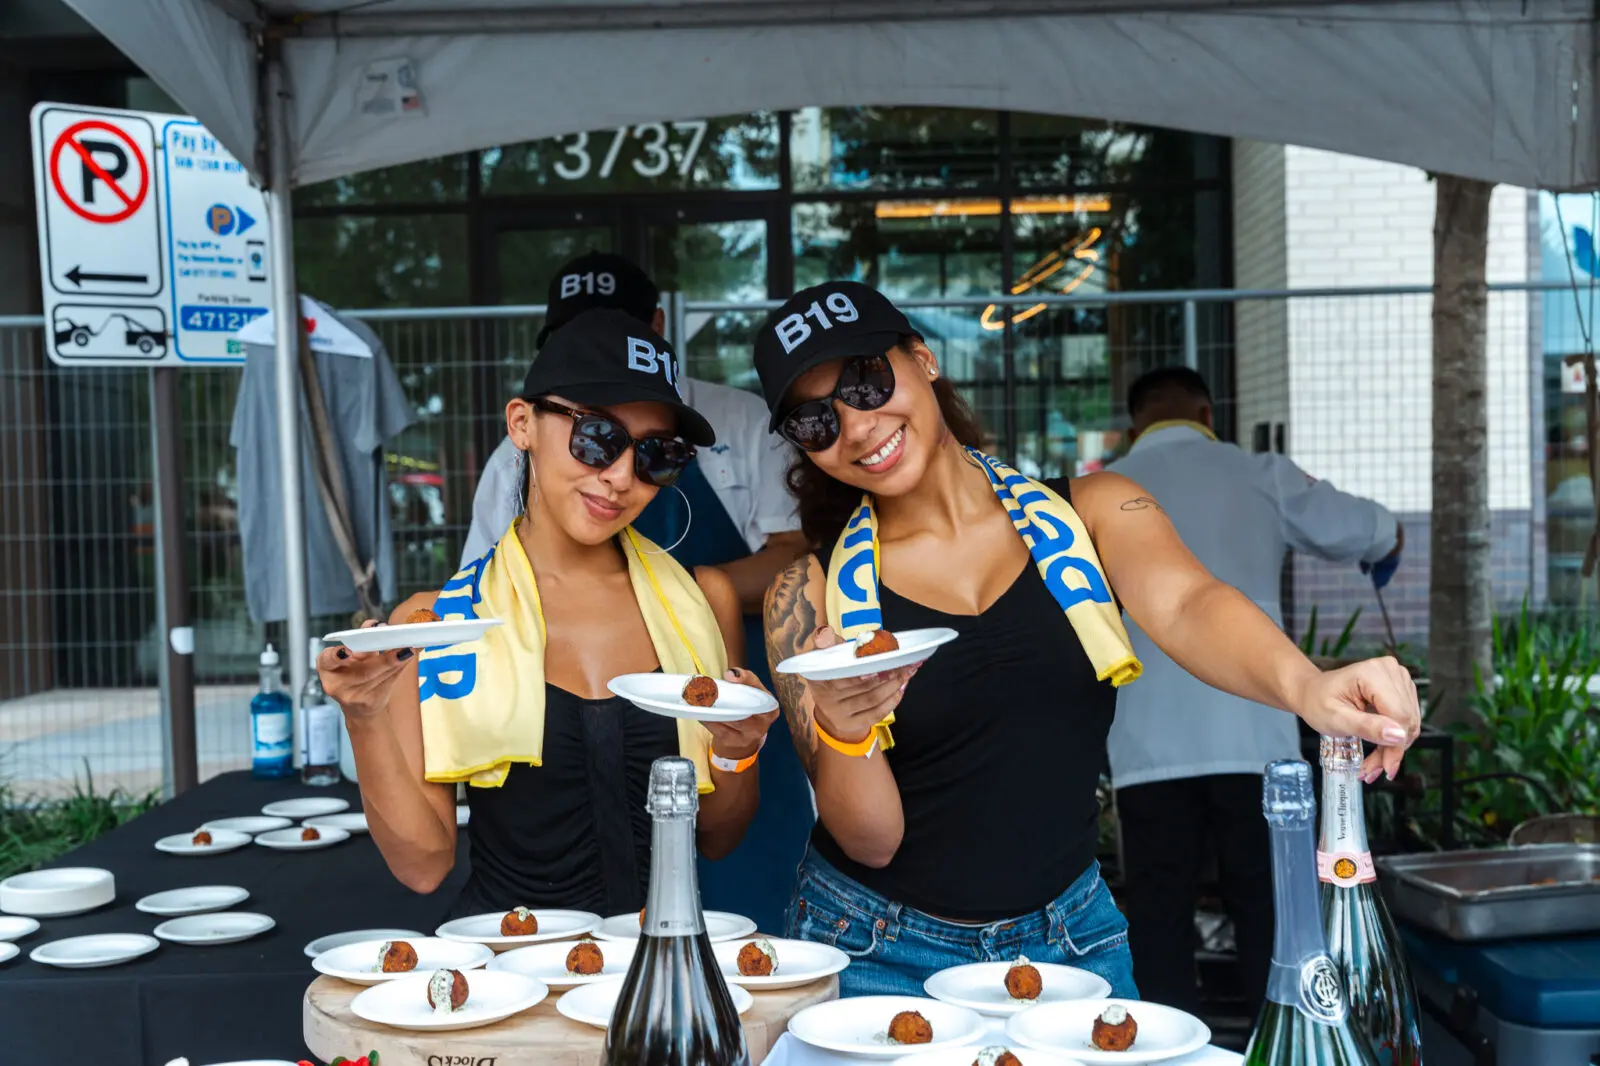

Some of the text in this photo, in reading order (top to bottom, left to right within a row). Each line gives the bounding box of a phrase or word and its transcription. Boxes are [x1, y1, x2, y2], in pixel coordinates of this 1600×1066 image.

[553, 120, 707, 180] 3737
[560, 271, 617, 300] B19
[187, 311, 260, 330] 47121
[773, 292, 860, 355] B19
